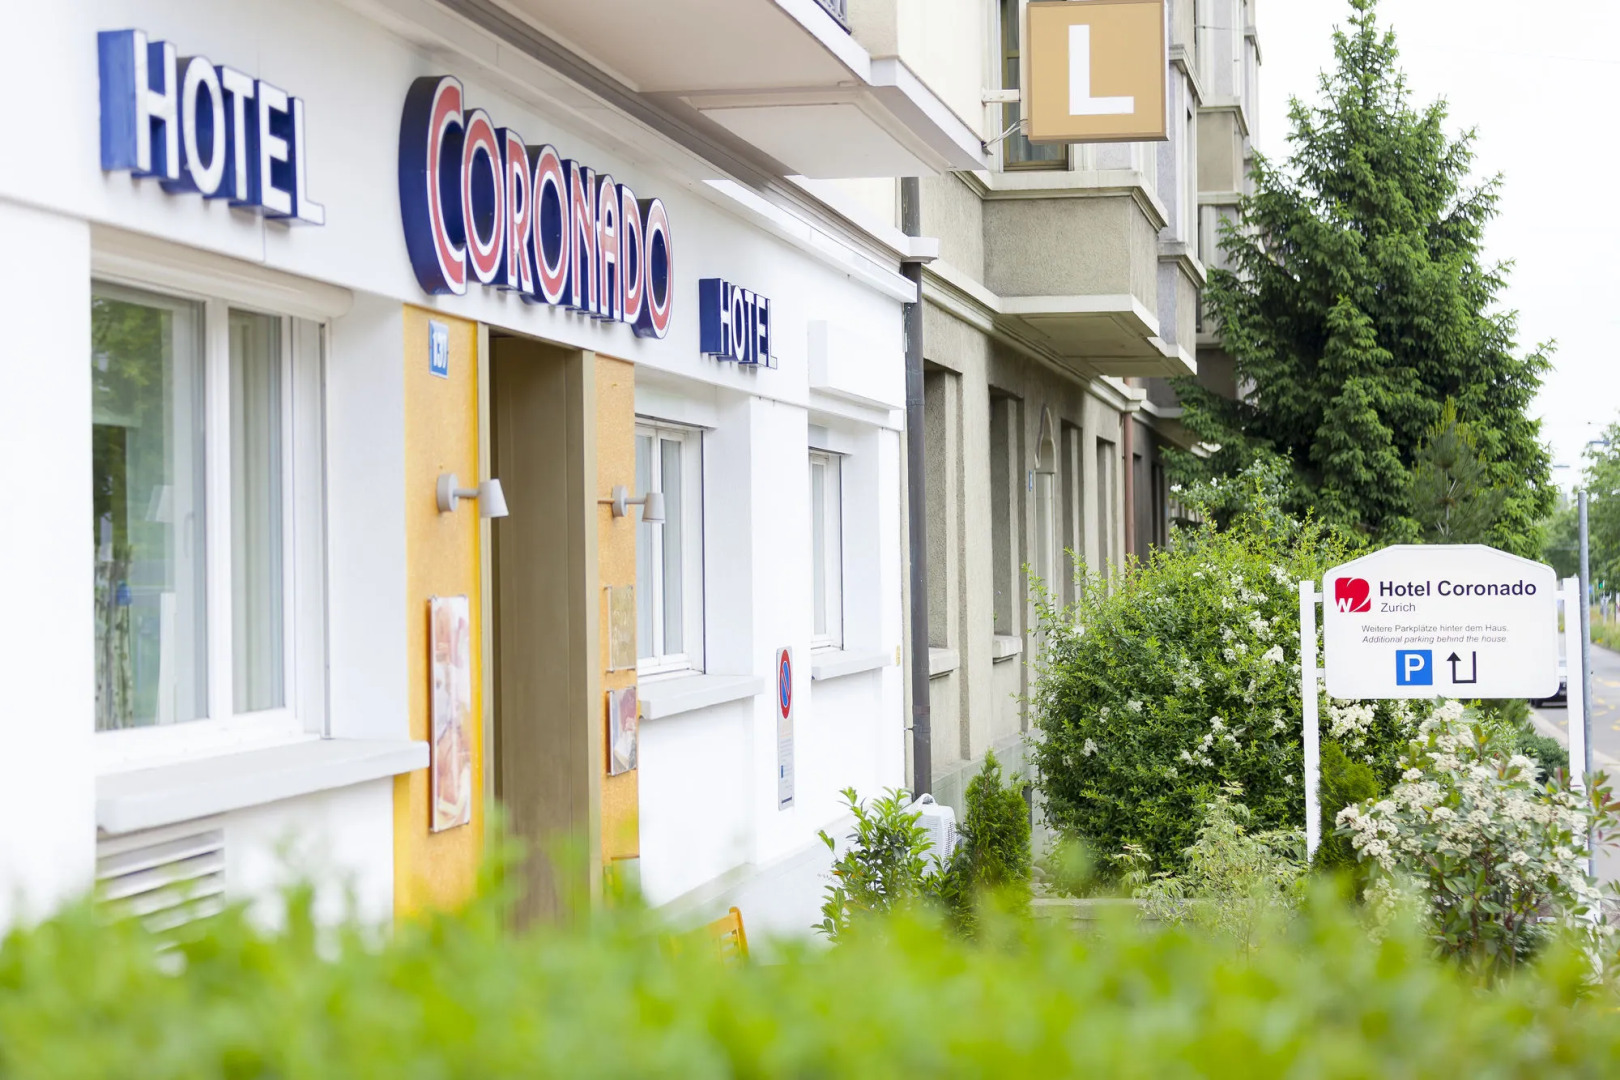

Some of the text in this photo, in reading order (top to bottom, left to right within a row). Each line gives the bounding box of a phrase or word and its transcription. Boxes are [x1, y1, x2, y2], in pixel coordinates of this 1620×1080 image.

[1069, 24, 1134, 115] L
[126, 29, 325, 226] HOTEL
[410, 75, 674, 339] CORONADO
[715, 278, 777, 370] HOTEL
[1379, 579, 1537, 597] Hotel Coronado
[1380, 602, 1416, 613] Zurich
[1361, 624, 1393, 633] Weitere
[1395, 624, 1438, 634] Parkplätze
[1440, 624, 1463, 632] hinter
[1465, 624, 1483, 632] dem
[1361, 635, 1403, 644] Additional
[1404, 635, 1435, 645] parking
[1436, 635, 1465, 643] behind
[1467, 634, 1479, 643] the
[1404, 653, 1426, 682] P
